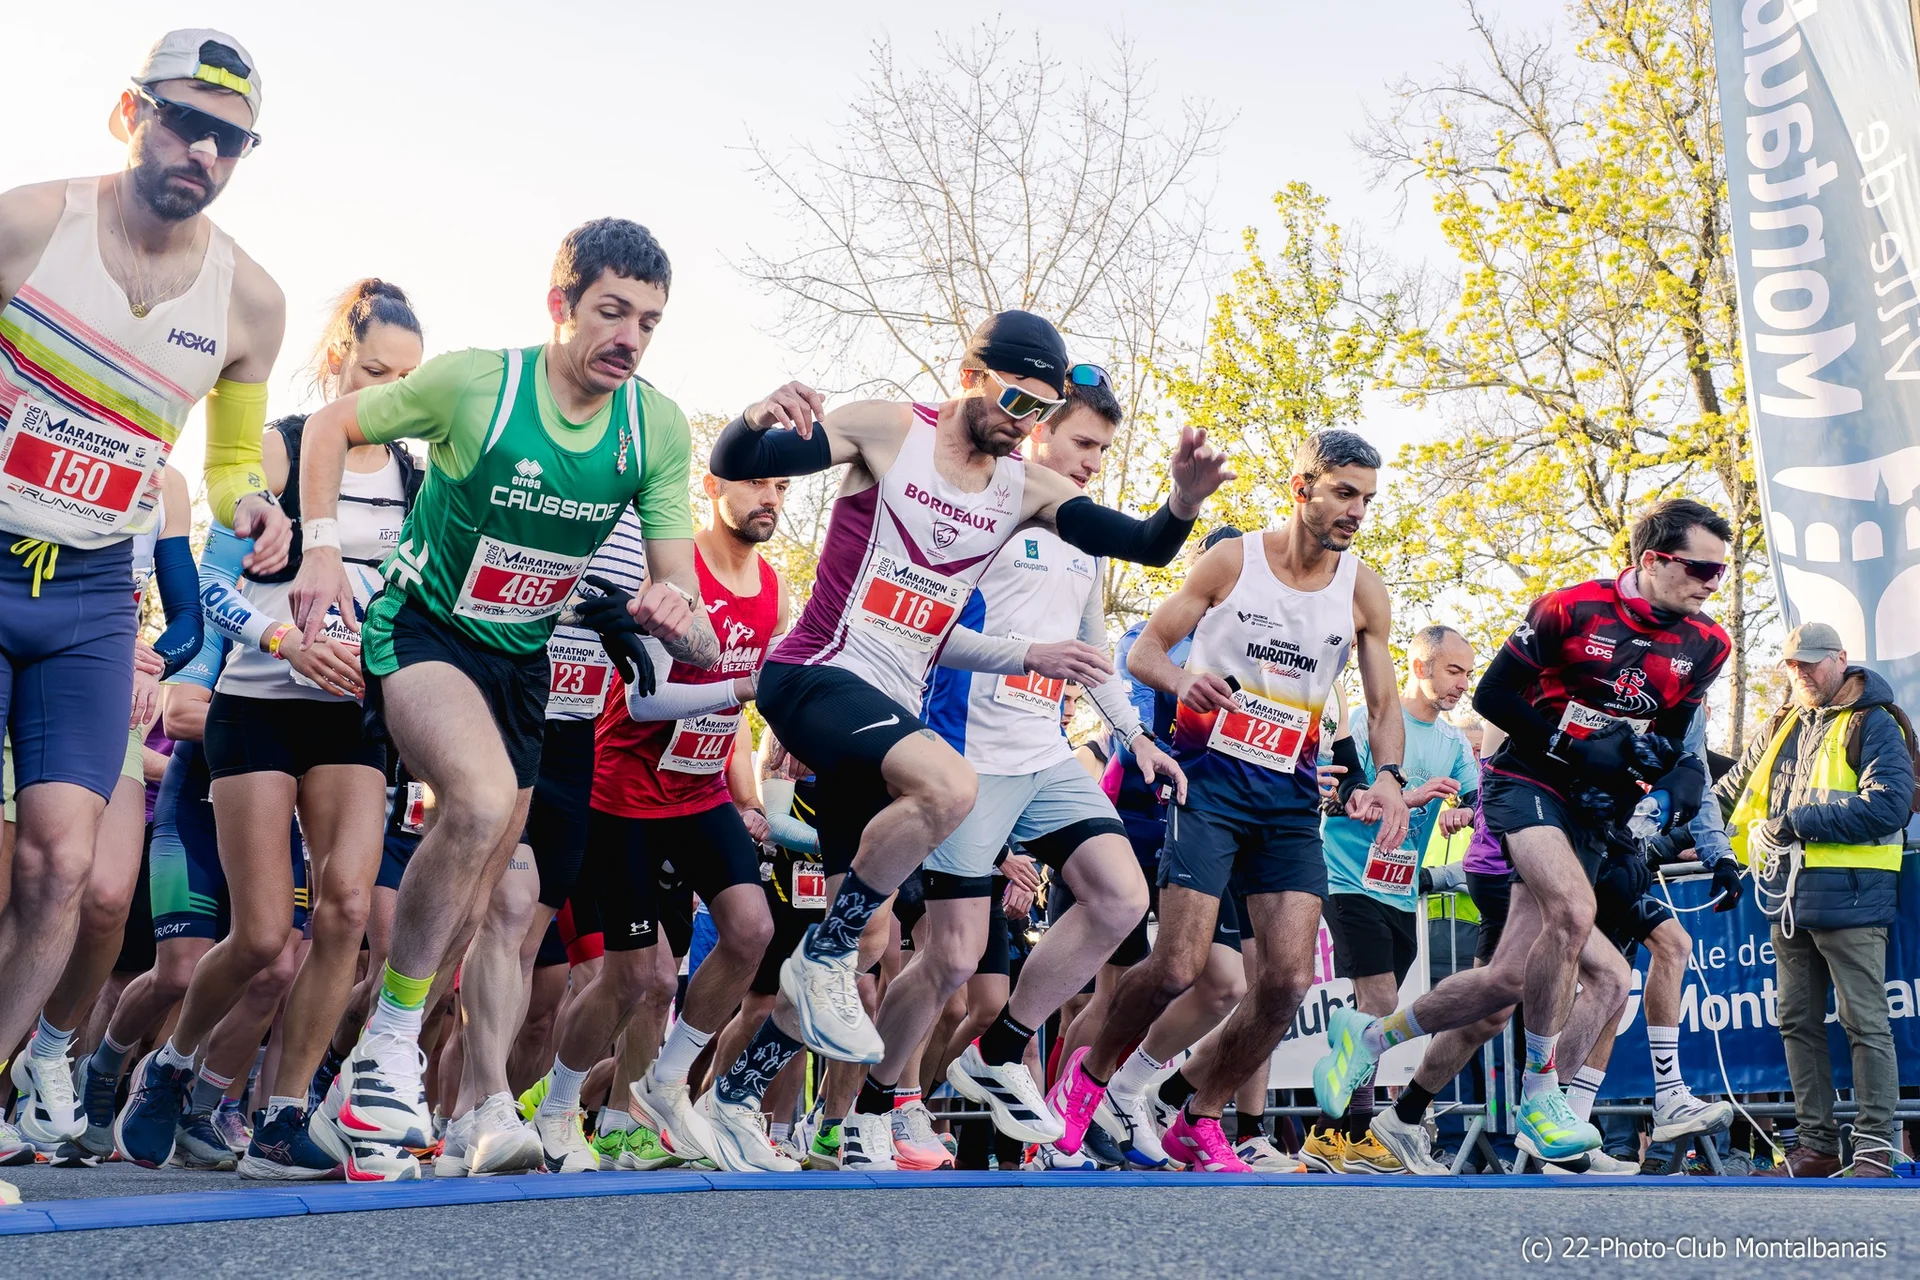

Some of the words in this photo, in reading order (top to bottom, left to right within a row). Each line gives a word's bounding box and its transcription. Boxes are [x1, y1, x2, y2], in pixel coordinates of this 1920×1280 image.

[167, 328, 216, 356] HOKA
[22, 405, 42, 432] 2026
[38, 410, 130, 454] MARATHON
[44, 449, 111, 502] 150
[490, 485, 620, 522] CAUSSADE
[904, 483, 997, 534] BORDEAUX
[485, 544, 500, 564] 2026
[498, 547, 573, 573] MARATHON
[877, 557, 890, 577] 2026
[1014, 559, 1048, 571] Groupama
[498, 575, 557, 606] 465
[888, 560, 948, 594] MARATHON
[205, 607, 242, 635] BLAGNAC
[890, 590, 934, 629] 116
[1270, 638, 1301, 653] VALENCIA
[1584, 645, 1613, 659] OPS
[1631, 638, 1652, 647] 42K
[1246, 642, 1318, 673] MARATHON
[1259, 660, 1301, 680] Paradise
[1243, 694, 1294, 721] MARATHON
[692, 735, 727, 759] 144
[1243, 718, 1284, 752] 124
[509, 858, 529, 870] Run
[1382, 863, 1407, 884] 114
[812, 876, 827, 896] 11
[1738, 934, 1777, 967] de
